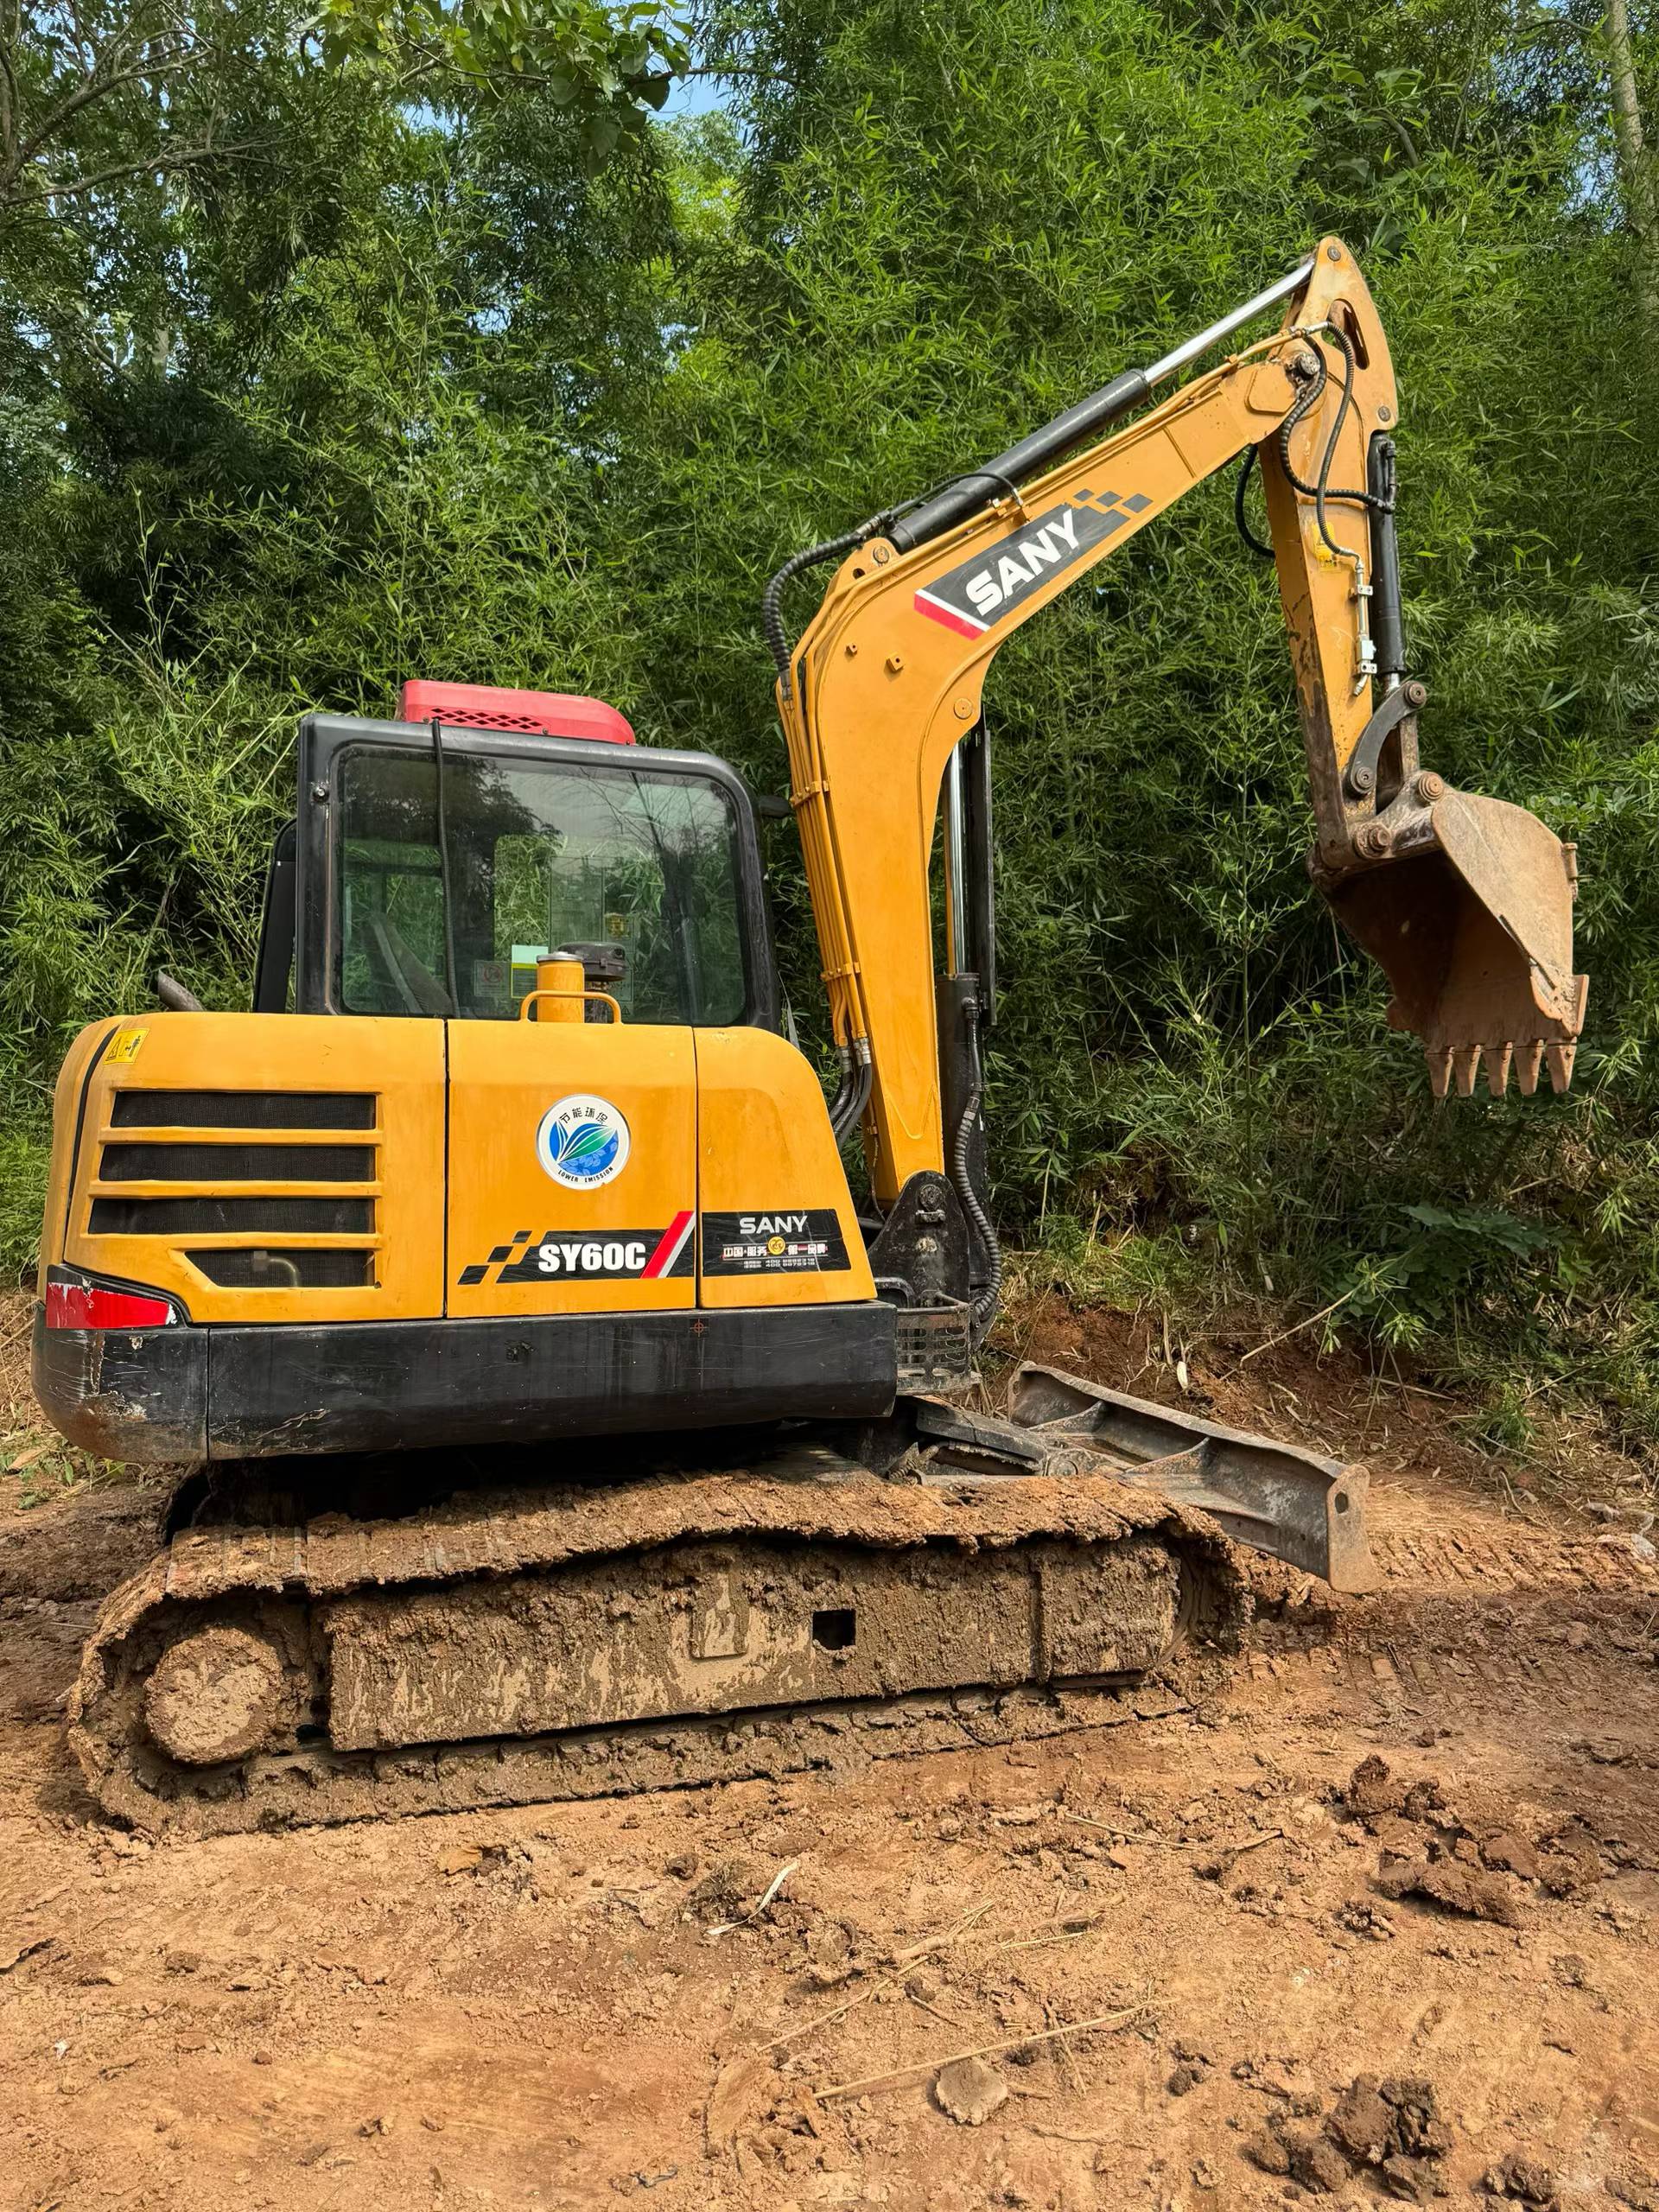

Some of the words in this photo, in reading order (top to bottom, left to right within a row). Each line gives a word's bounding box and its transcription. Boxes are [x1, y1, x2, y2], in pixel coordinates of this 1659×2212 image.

[965, 508, 1079, 617] SANY
[559, 1107, 608, 1124] 节能环保
[557, 1169, 579, 1182] LOWER
[584, 1166, 613, 1183] EMISSION
[739, 1216, 808, 1234] SANY
[538, 1243, 646, 1272] SY60C
